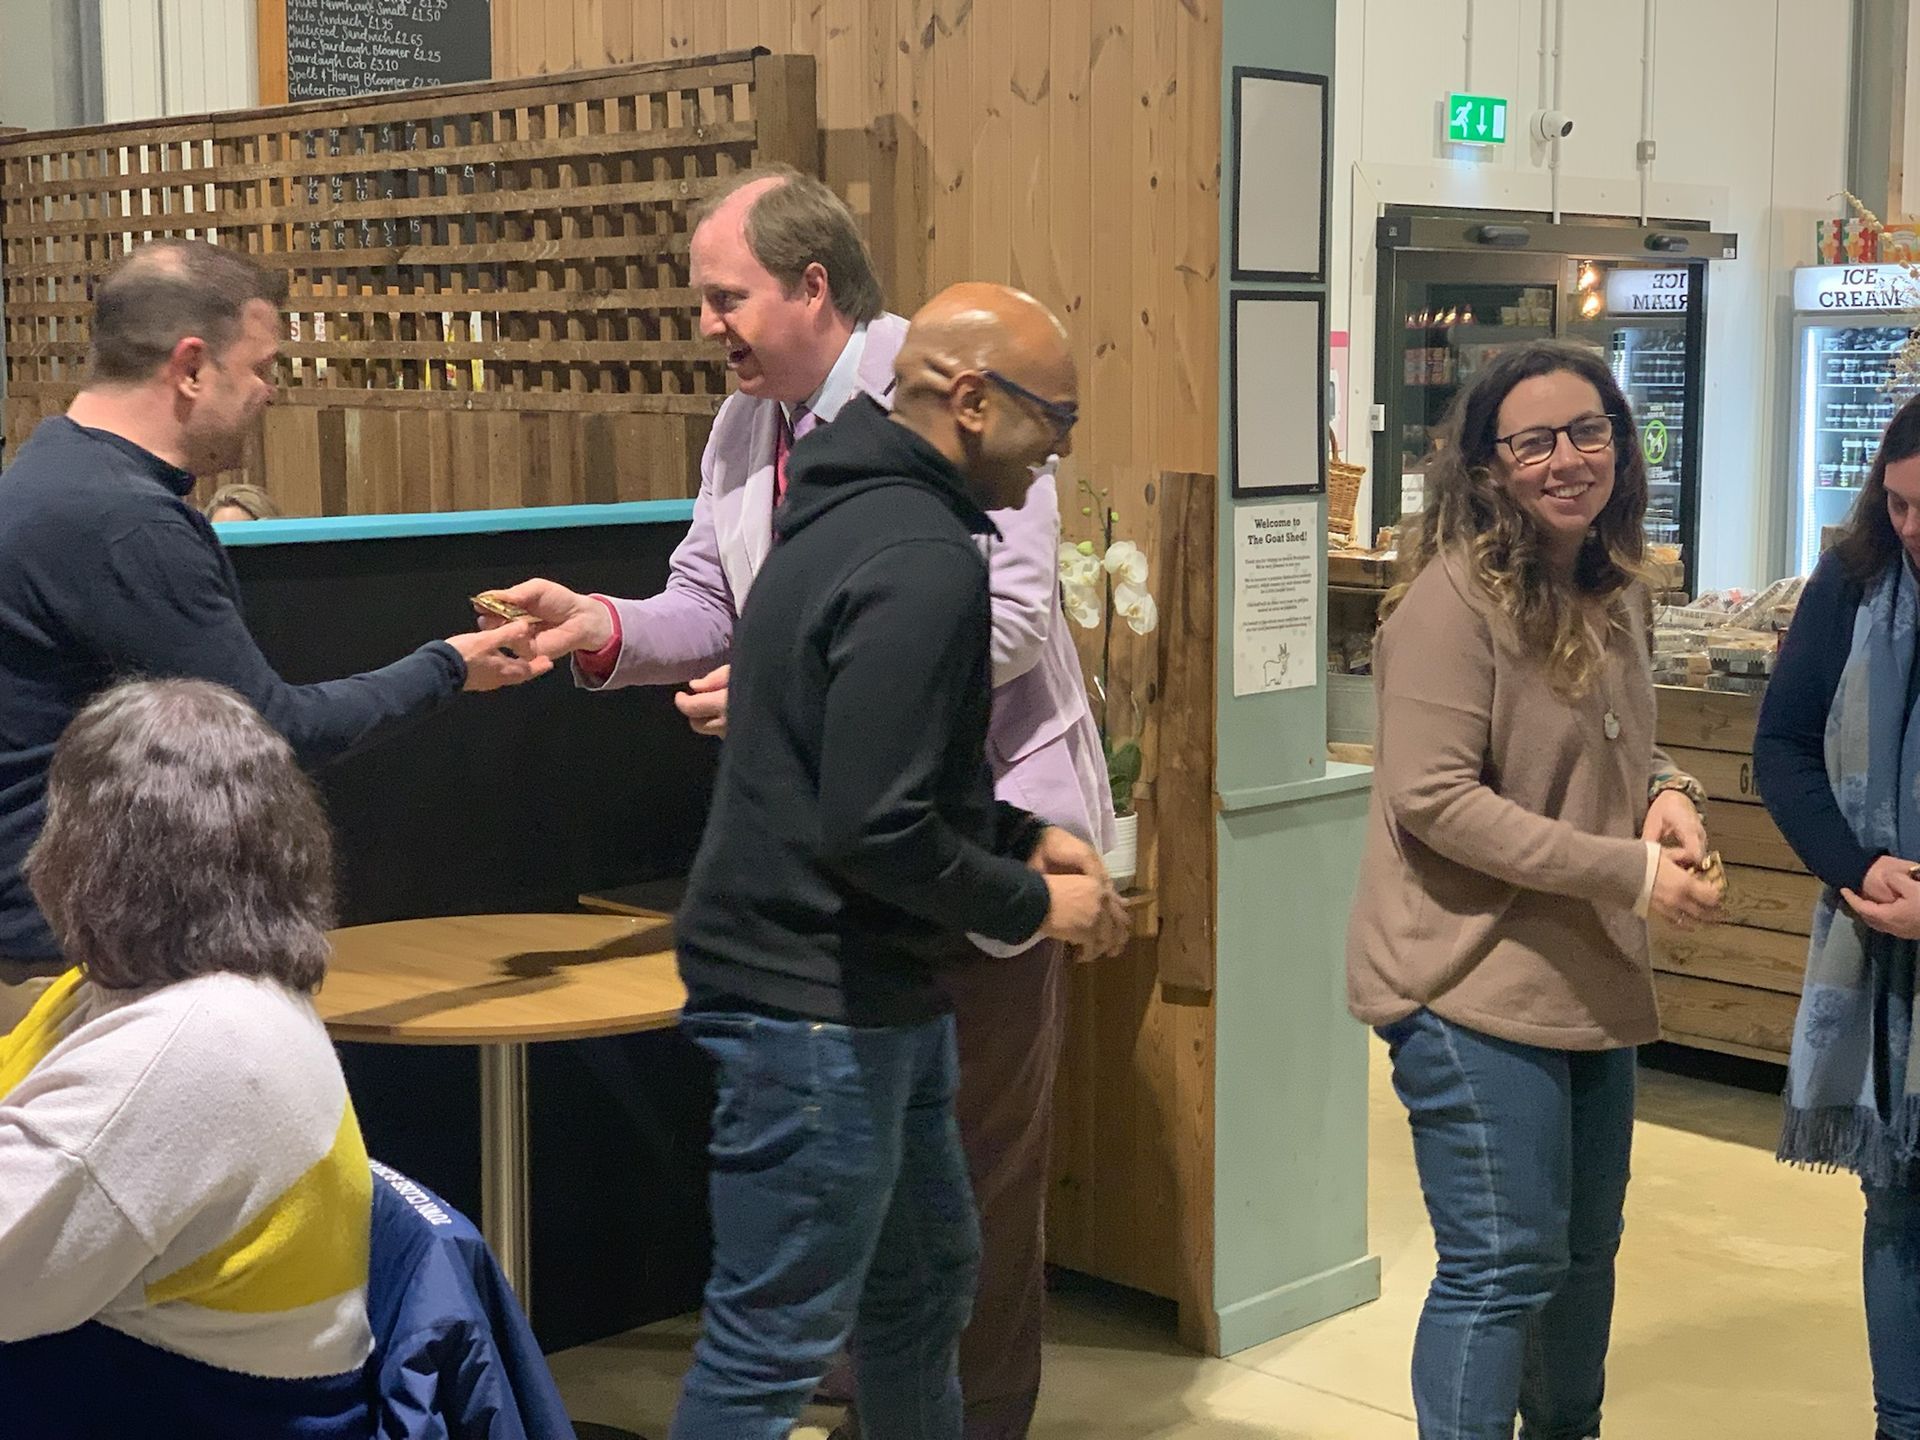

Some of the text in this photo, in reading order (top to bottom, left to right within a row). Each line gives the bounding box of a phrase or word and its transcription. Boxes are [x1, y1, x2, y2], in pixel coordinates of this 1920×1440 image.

[347, 56, 367, 70] Cob
[1842, 268, 1878, 285] ICE
[1819, 290, 1902, 308] CREAM
[1254, 517, 1301, 529] Welcome to
[1247, 531, 1308, 545] The Goat Shed!
